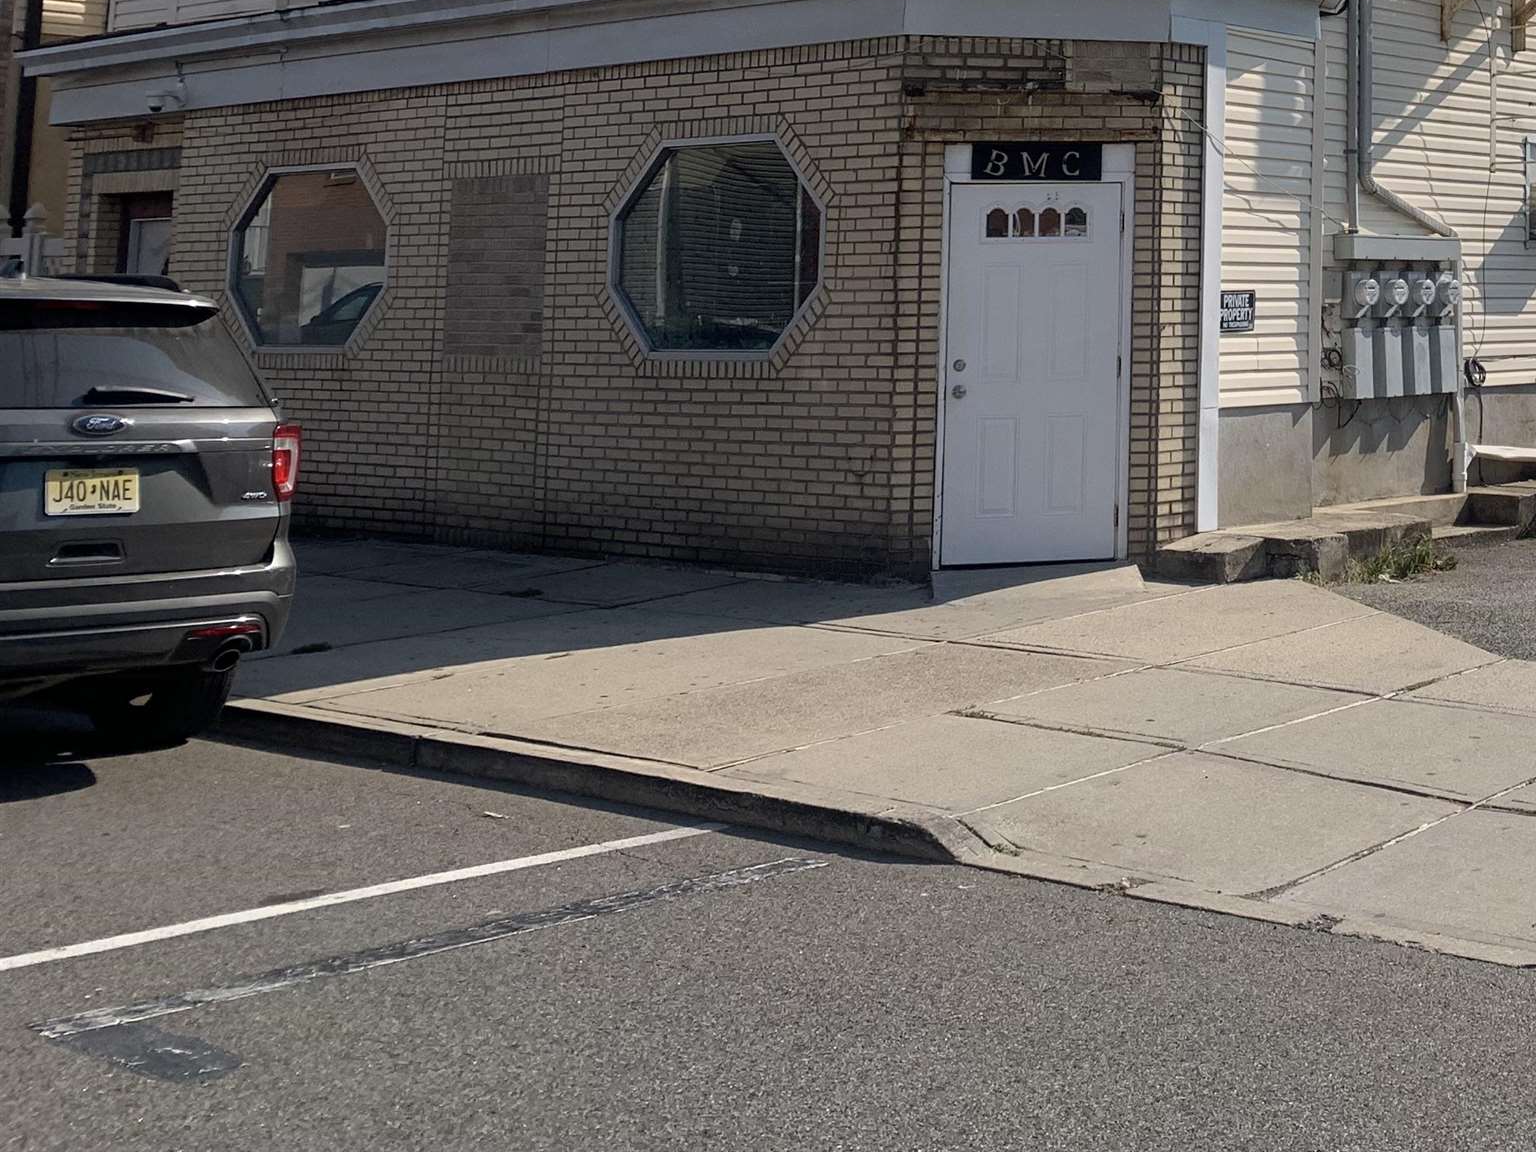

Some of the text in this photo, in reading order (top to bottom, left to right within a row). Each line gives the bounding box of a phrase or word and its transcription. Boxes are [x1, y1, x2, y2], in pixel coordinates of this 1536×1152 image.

[984, 149, 1080, 177] BMC
[1223, 294, 1249, 308] PRIVATE
[1219, 308, 1253, 321] PROPERTY
[87, 417, 117, 429] Ford
[53, 479, 132, 502] J40 NAE
